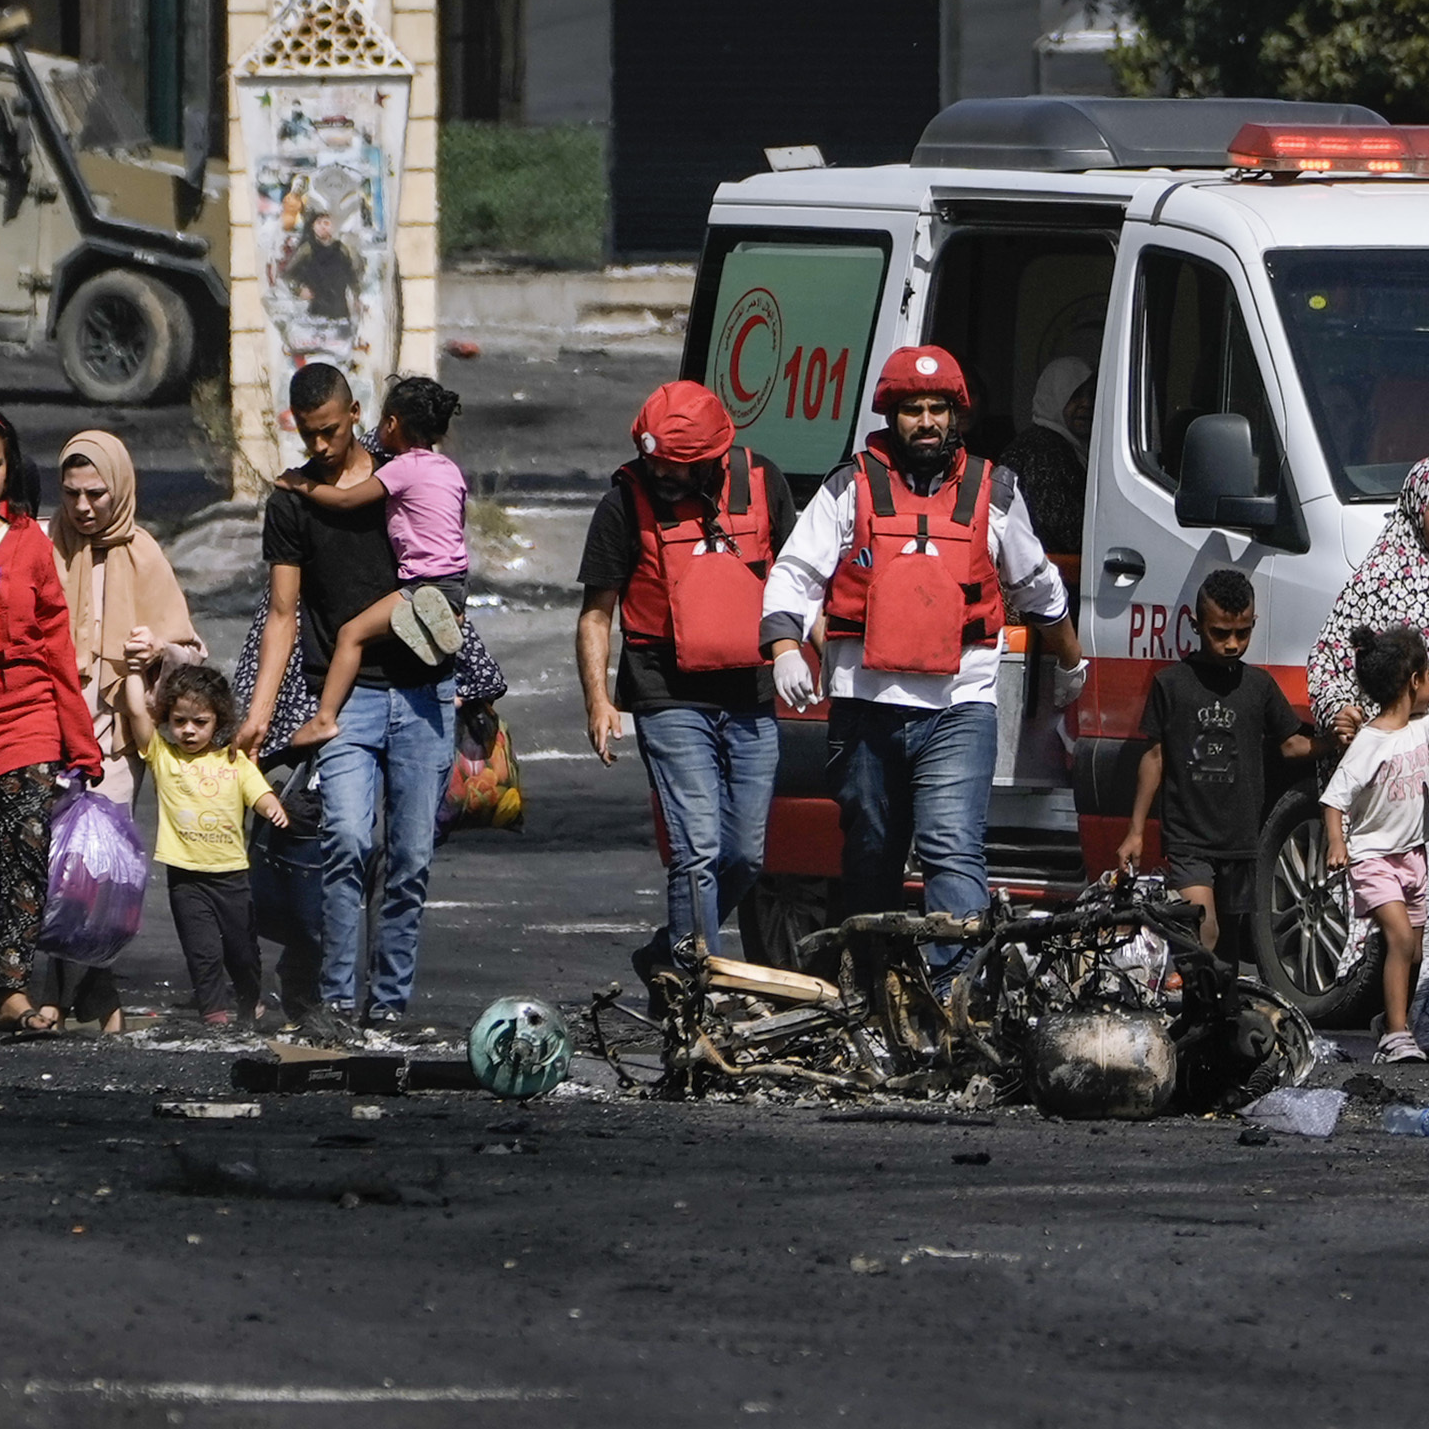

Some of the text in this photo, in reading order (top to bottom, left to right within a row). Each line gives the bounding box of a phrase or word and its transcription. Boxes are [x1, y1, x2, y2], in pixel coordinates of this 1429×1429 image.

[783, 346, 849, 420] 101
[180, 762, 239, 781] COLLECT
[179, 830, 234, 844] MOMENTS
